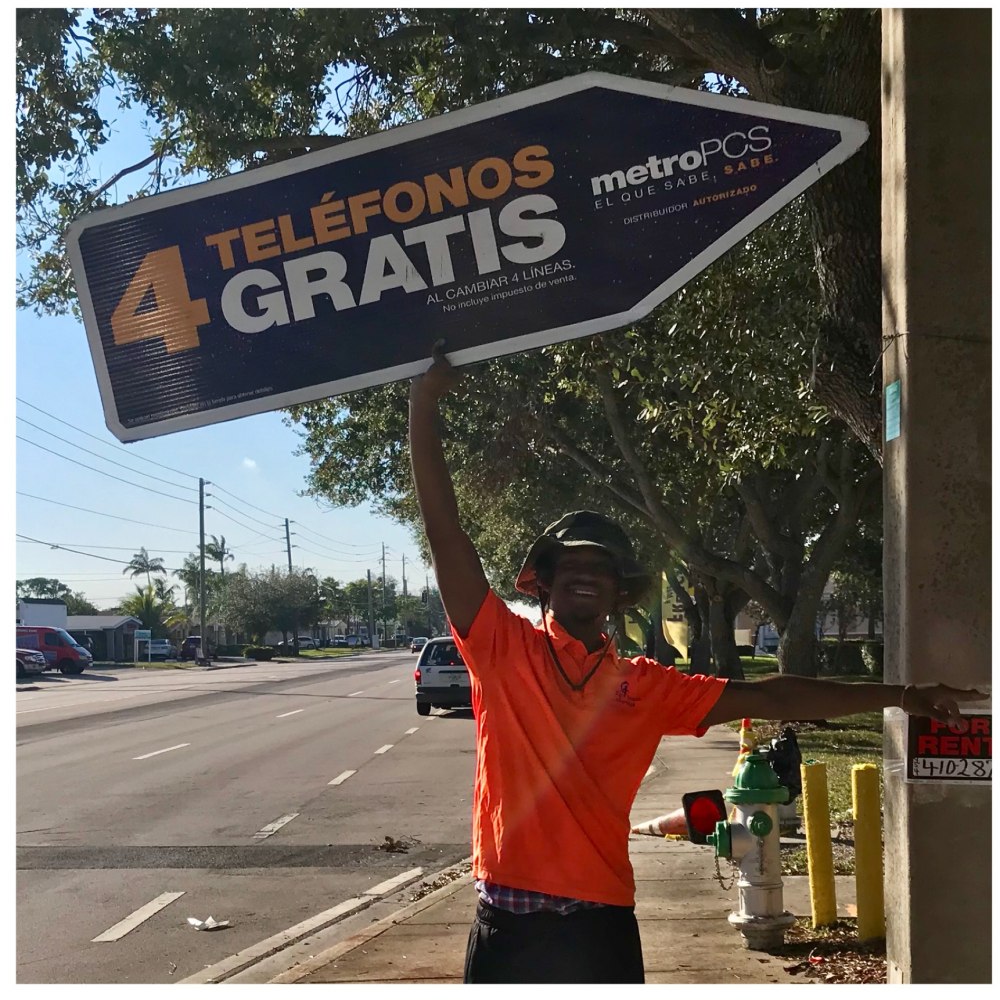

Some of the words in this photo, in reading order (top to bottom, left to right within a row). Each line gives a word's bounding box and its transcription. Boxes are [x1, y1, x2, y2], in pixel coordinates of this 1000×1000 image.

[590, 126, 772, 196] metroPCS
[594, 198, 614, 209] EL
[621, 185, 656, 202] QUE
[723, 153, 779, 175] SABE.
[623, 202, 688, 225] DISTRIBUIDOR
[692, 184, 758, 207] AUTORIZADO
[111, 245, 211, 356] 4
[204, 145, 555, 270] TELÉFONOS
[221, 194, 567, 334] GRATIS
[426, 293, 443, 305] AL
[445, 276, 509, 300] CAMBIAR
[511, 273, 519, 283] 4
[522, 259, 576, 281] LÍNEAS.
[443, 304, 456, 313] No
[458, 295, 489, 309] incluye
[491, 284, 533, 301] impuesto
[535, 281, 547, 289] de
[548, 273, 577, 288] venta.
[931, 717, 990, 735] FOR
